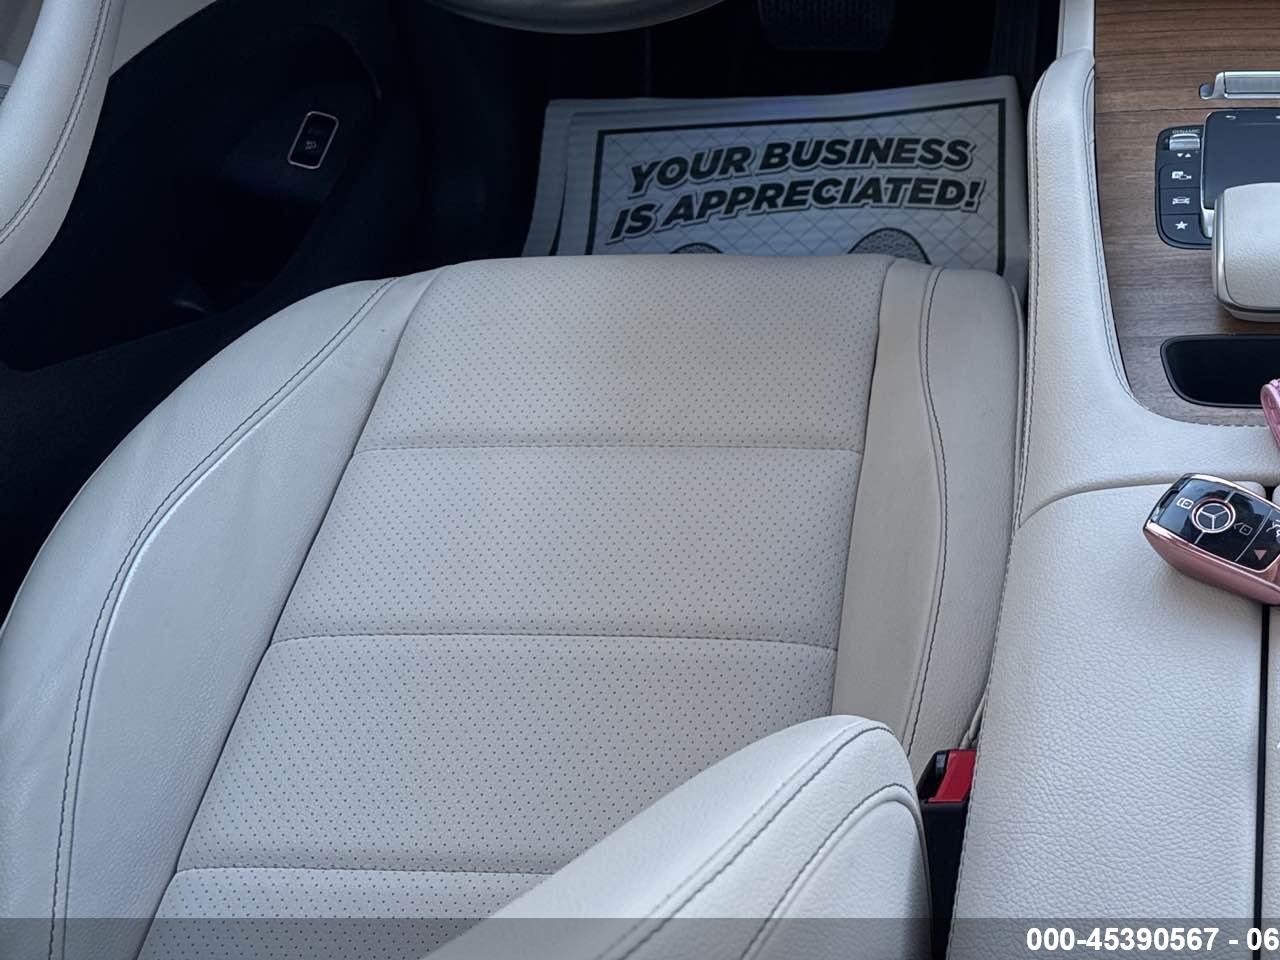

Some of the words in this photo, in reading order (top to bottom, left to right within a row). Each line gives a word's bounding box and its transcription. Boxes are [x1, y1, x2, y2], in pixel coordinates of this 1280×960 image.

[629, 146, 752, 194] YOUR
[757, 137, 976, 172] BUSINESS
[608, 204, 657, 241] IS
[660, 176, 986, 230] APPRECIATED!
